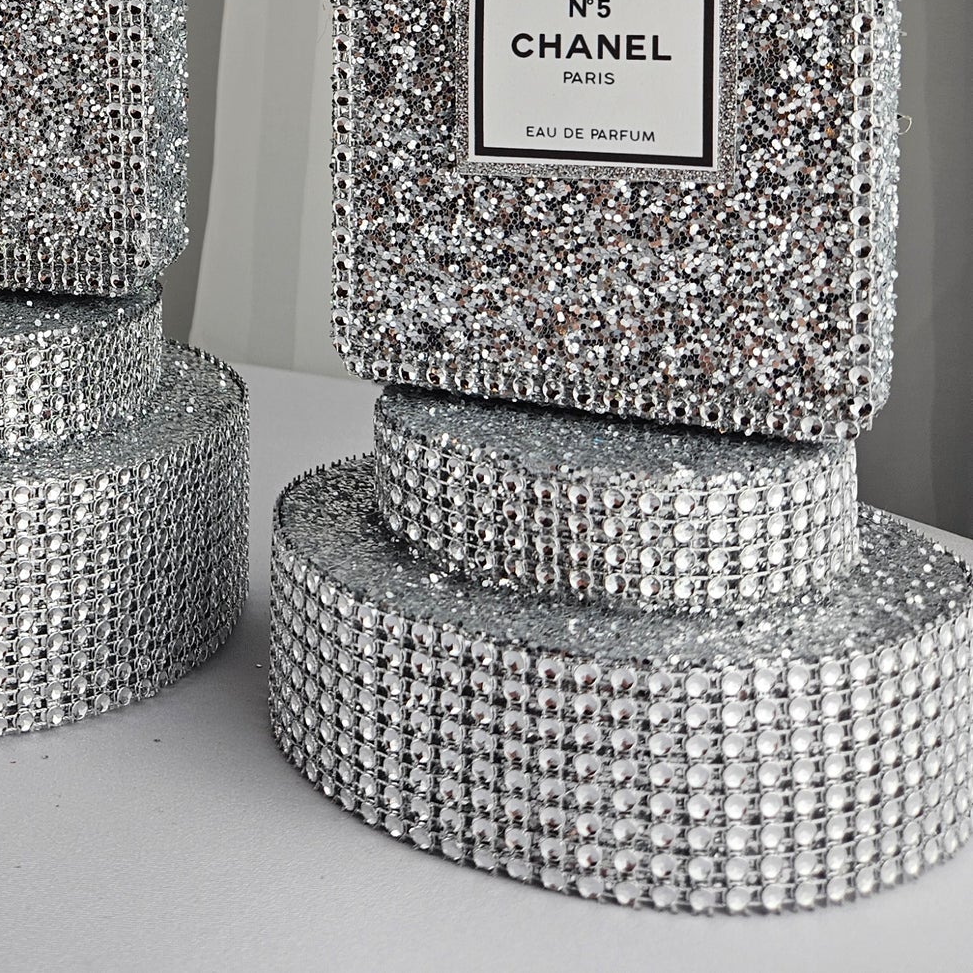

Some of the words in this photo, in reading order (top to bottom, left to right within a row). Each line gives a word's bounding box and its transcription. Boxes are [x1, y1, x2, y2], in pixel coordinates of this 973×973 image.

[510, 32, 672, 61] CHANEL
[563, 71, 615, 85] PARIS
[526, 125, 557, 138] EAU
[563, 127, 584, 140] DE
[590, 128, 655, 143] PARFUM
